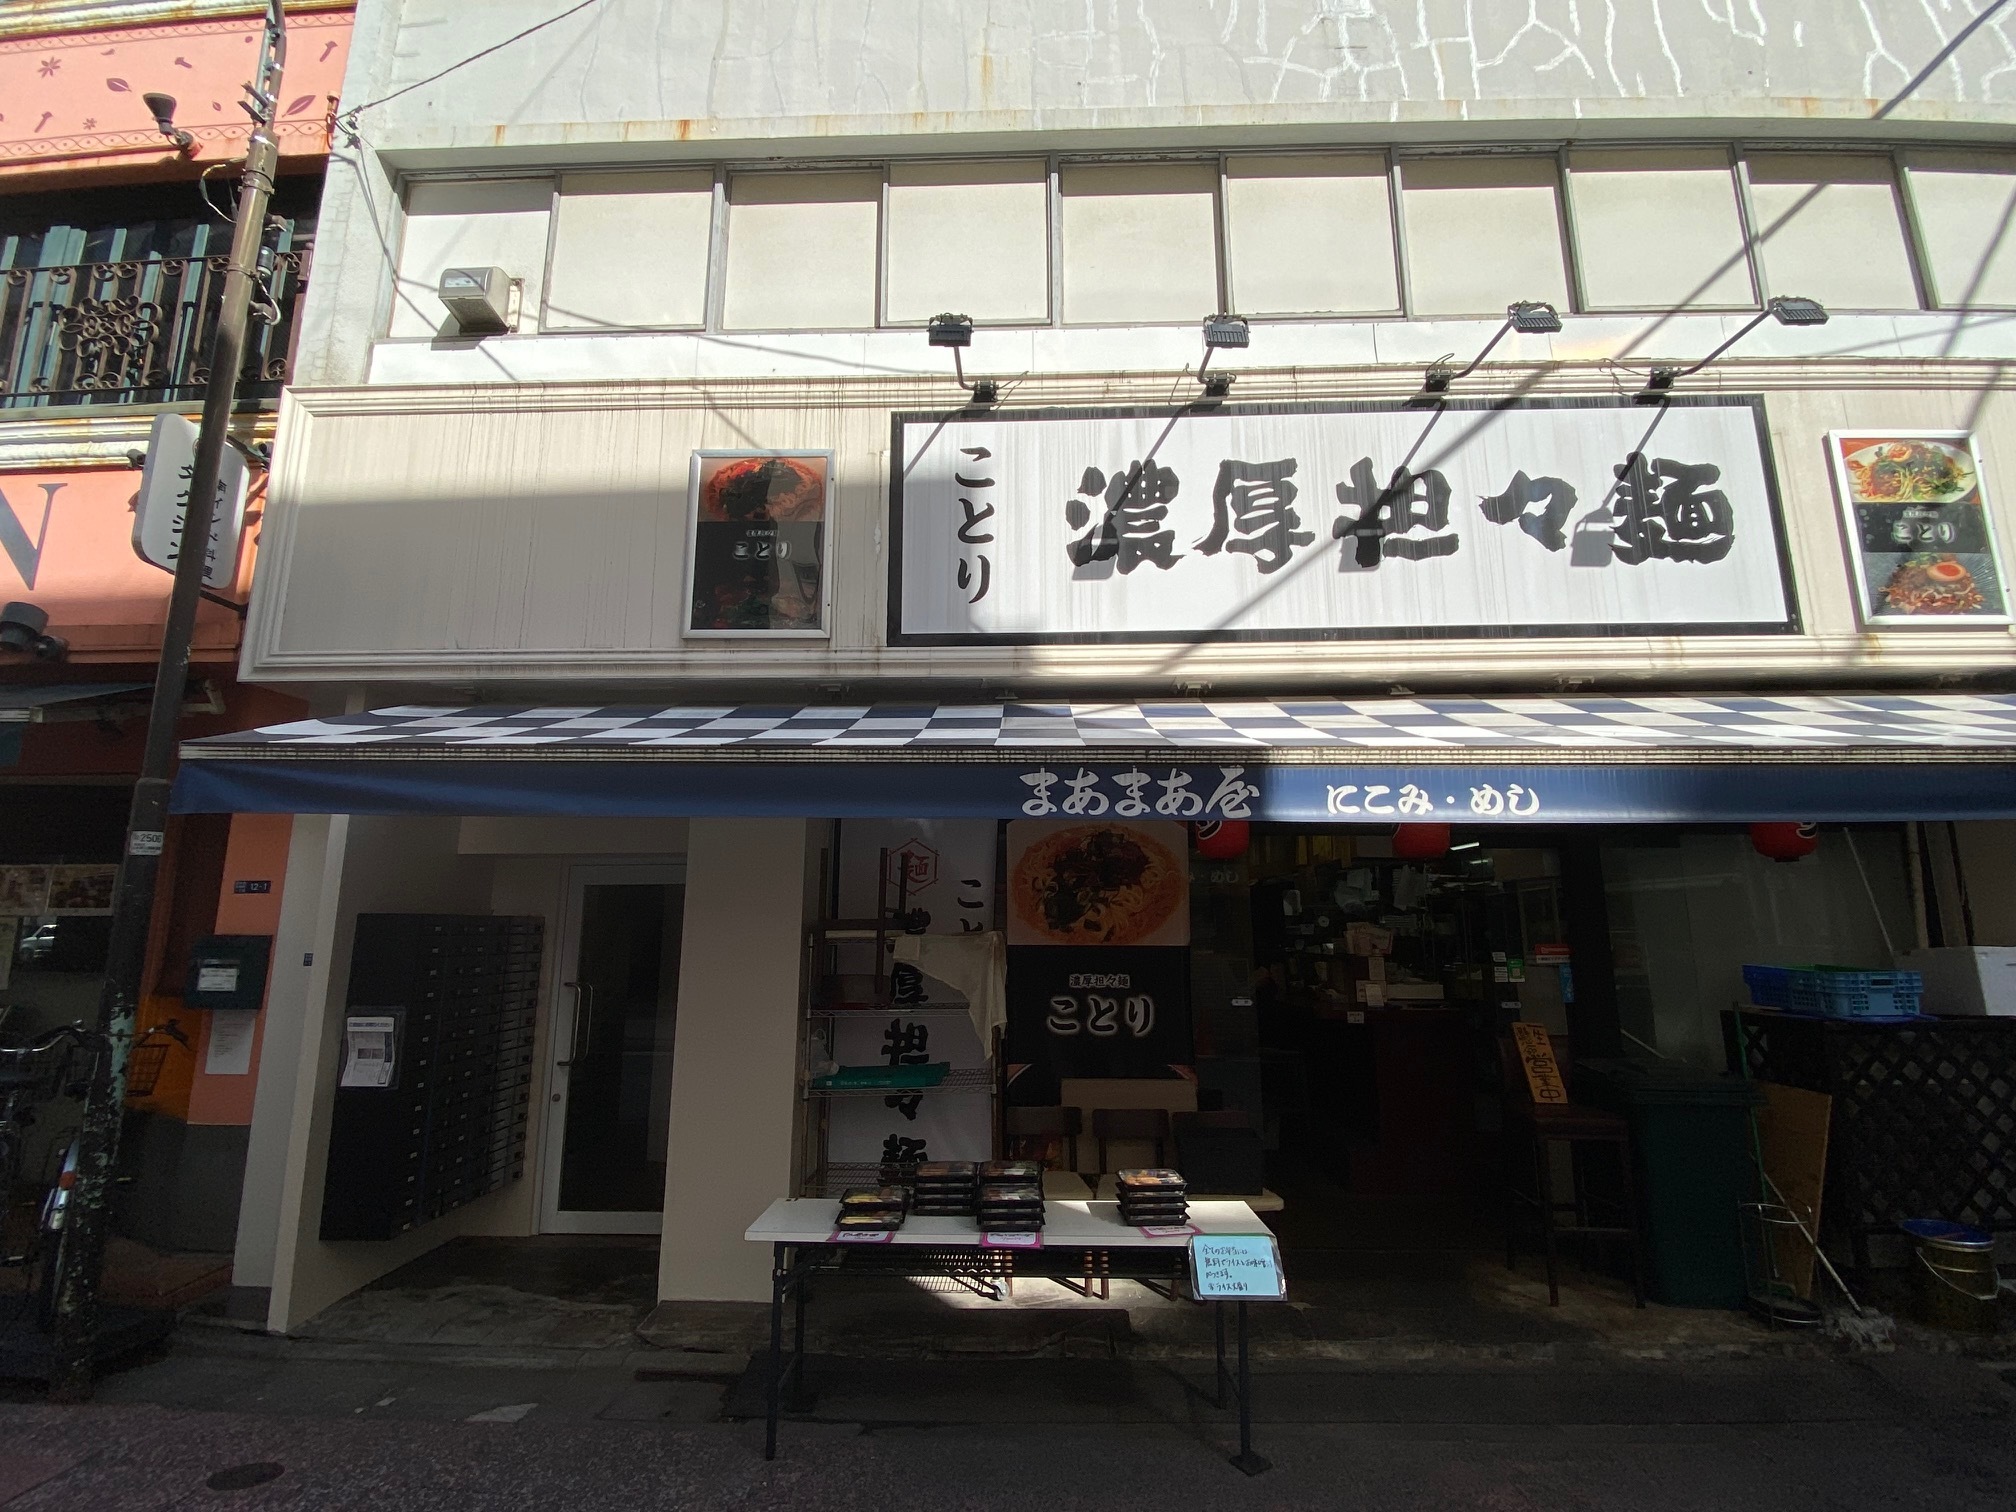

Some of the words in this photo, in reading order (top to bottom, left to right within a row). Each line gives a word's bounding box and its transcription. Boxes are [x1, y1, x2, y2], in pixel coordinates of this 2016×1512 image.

[955, 447, 994, 604] ことり
[1065, 452, 1735, 574] 濃厚担々麺
[1891, 520, 1955, 543] ことり
[733, 541, 790, 560] ことり
[1019, 767, 1261, 819] まあまあ屋
[1327, 783, 1540, 816] にこみ・めし
[1069, 974, 1130, 988] 濃厚担々麺
[1048, 994, 1154, 1036] ことり
